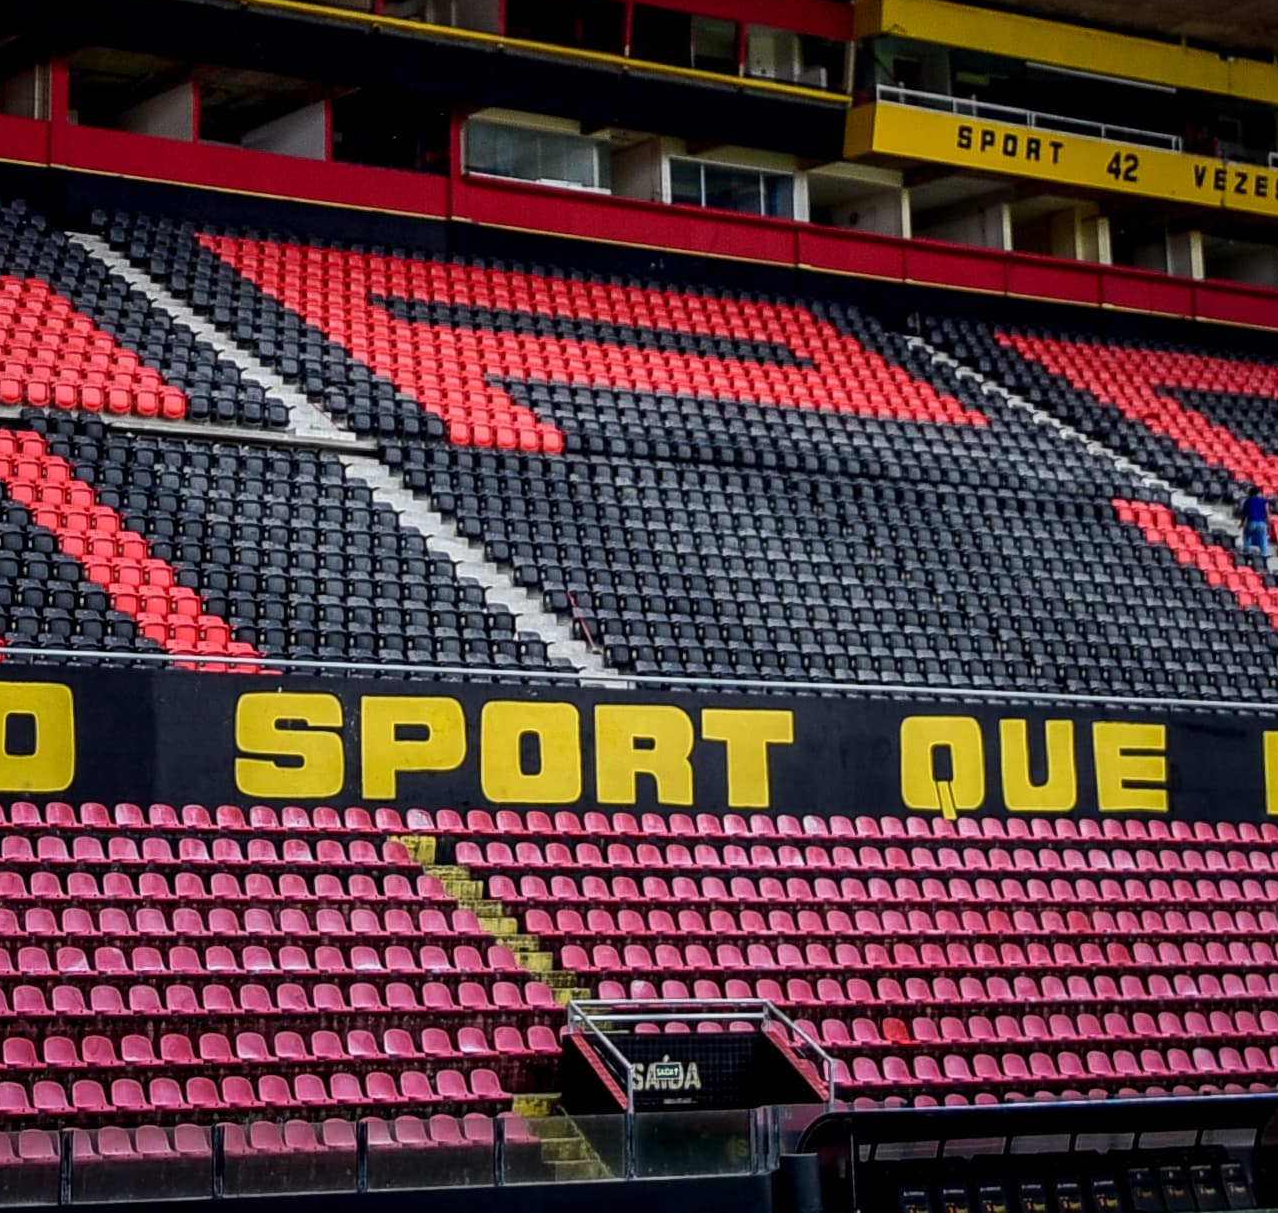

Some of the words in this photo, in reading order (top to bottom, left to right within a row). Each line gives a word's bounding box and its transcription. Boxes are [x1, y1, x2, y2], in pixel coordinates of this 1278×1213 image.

[956, 124, 1064, 165] SPORT
[1105, 151, 1140, 183] 42
[233, 691, 795, 810] SPORT
[898, 715, 1170, 821] QUE
